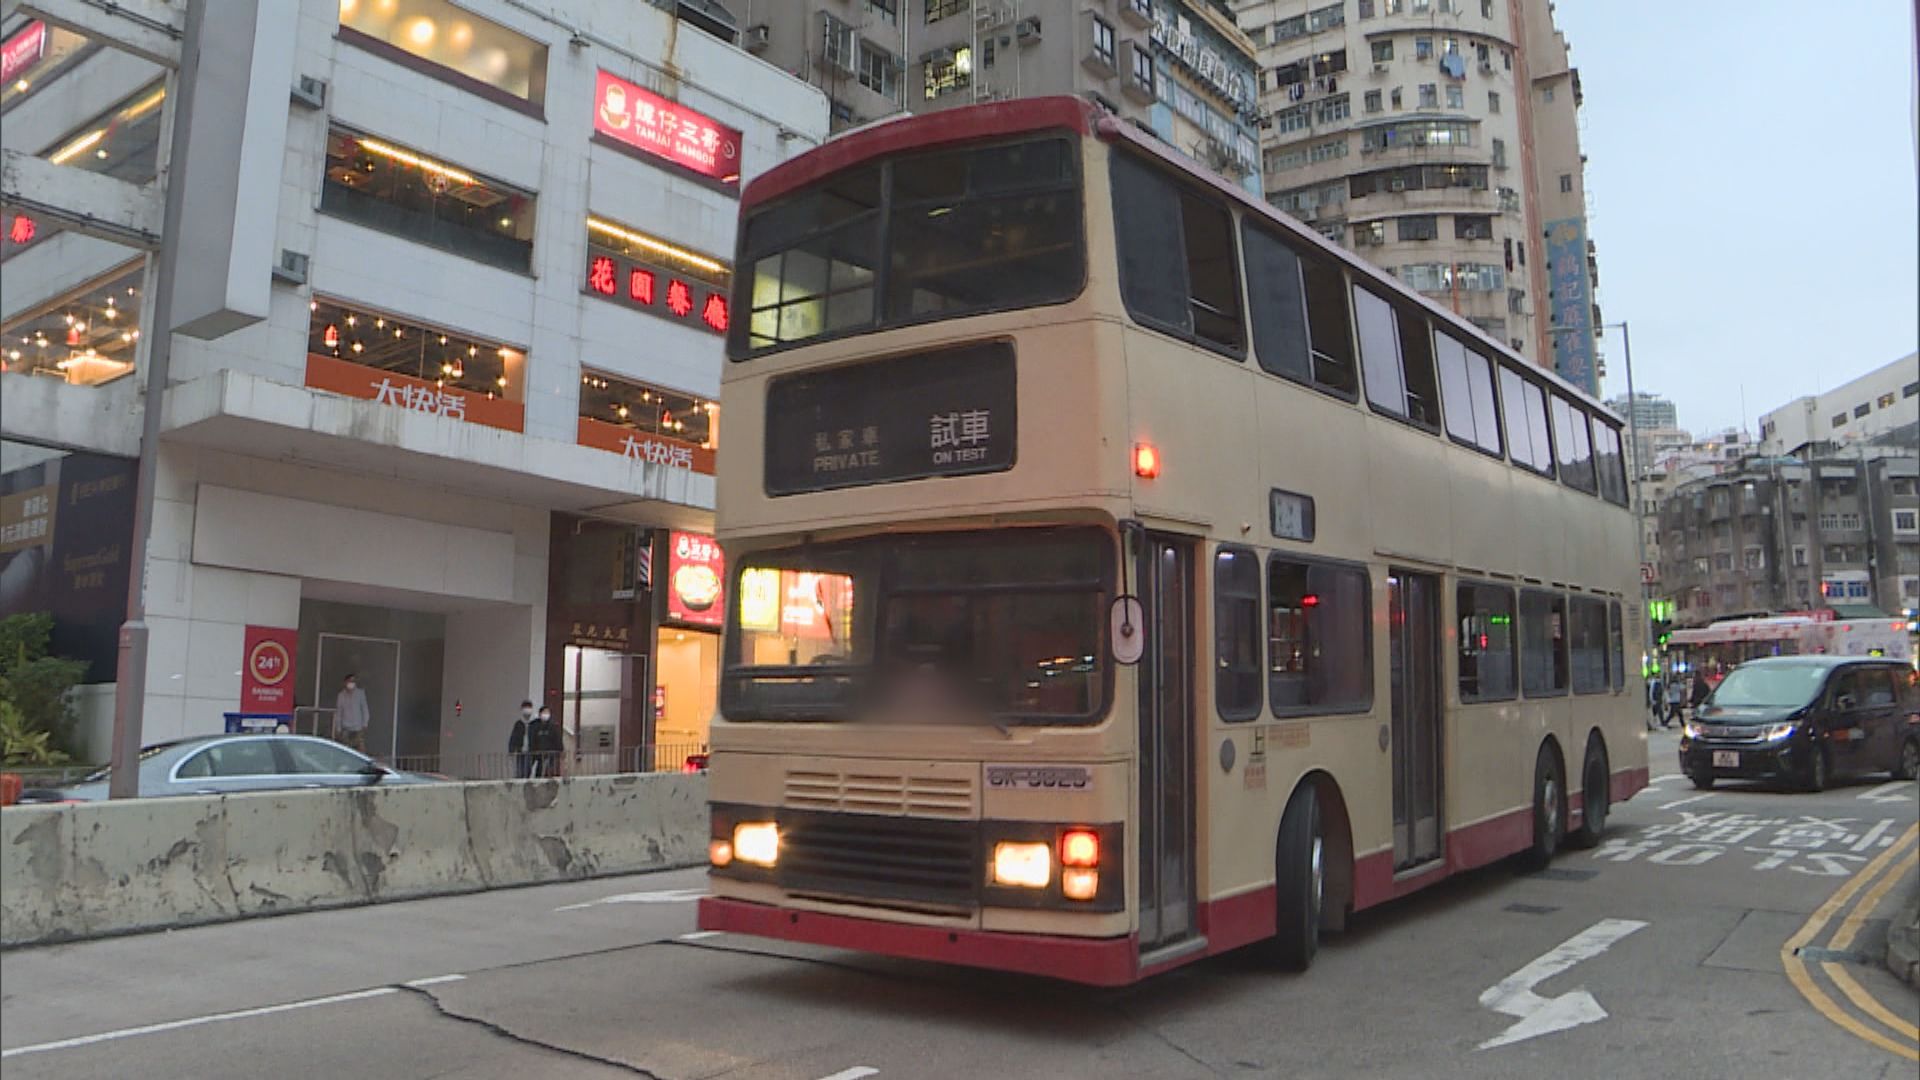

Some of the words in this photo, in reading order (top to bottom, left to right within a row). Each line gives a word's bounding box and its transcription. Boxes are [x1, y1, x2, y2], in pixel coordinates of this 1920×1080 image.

[589, 255, 729, 333] 花園餐廳
[369, 377, 466, 421] 大快活
[929, 409, 991, 449] 試車
[618, 434, 695, 470] 大快活
[813, 450, 881, 472] PRIVATE
[932, 451, 953, 464] ON
[956, 447, 989, 462] TEST
